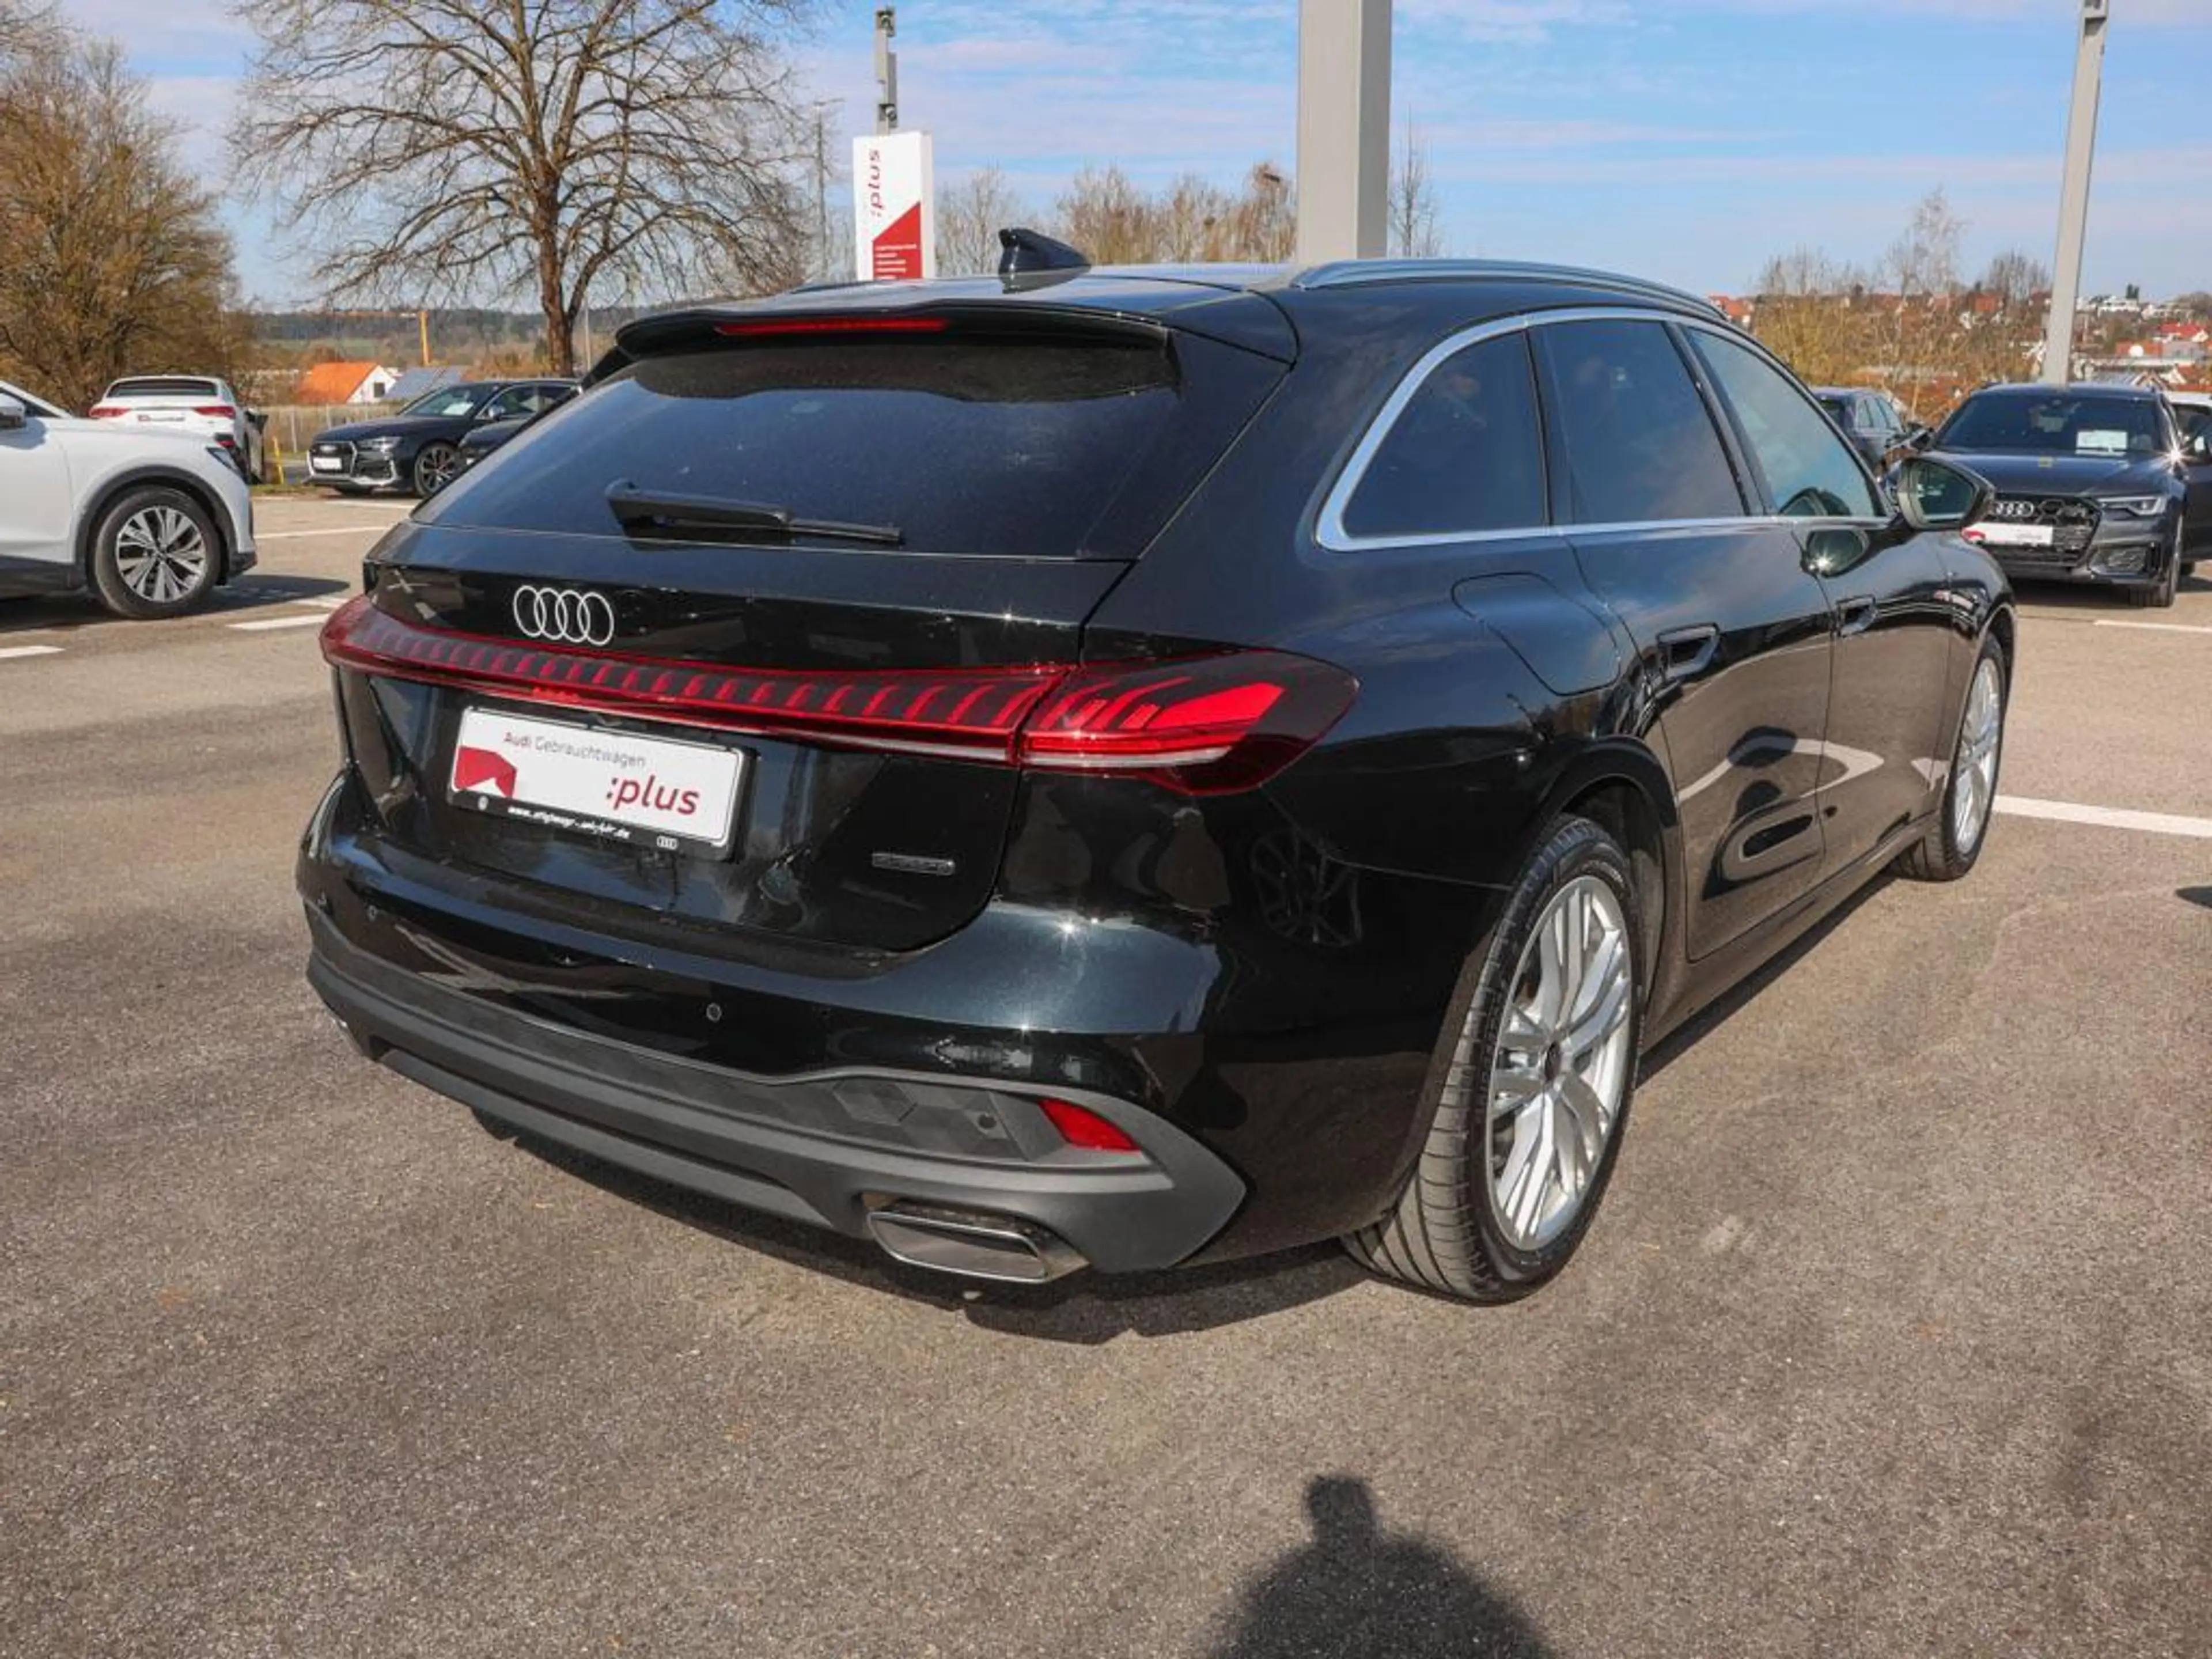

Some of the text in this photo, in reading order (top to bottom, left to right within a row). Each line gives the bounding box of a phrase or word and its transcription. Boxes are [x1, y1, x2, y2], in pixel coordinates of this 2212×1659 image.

[503, 732, 645, 768] Audi Gebrauchtwagen
[606, 774, 700, 815] :plus
